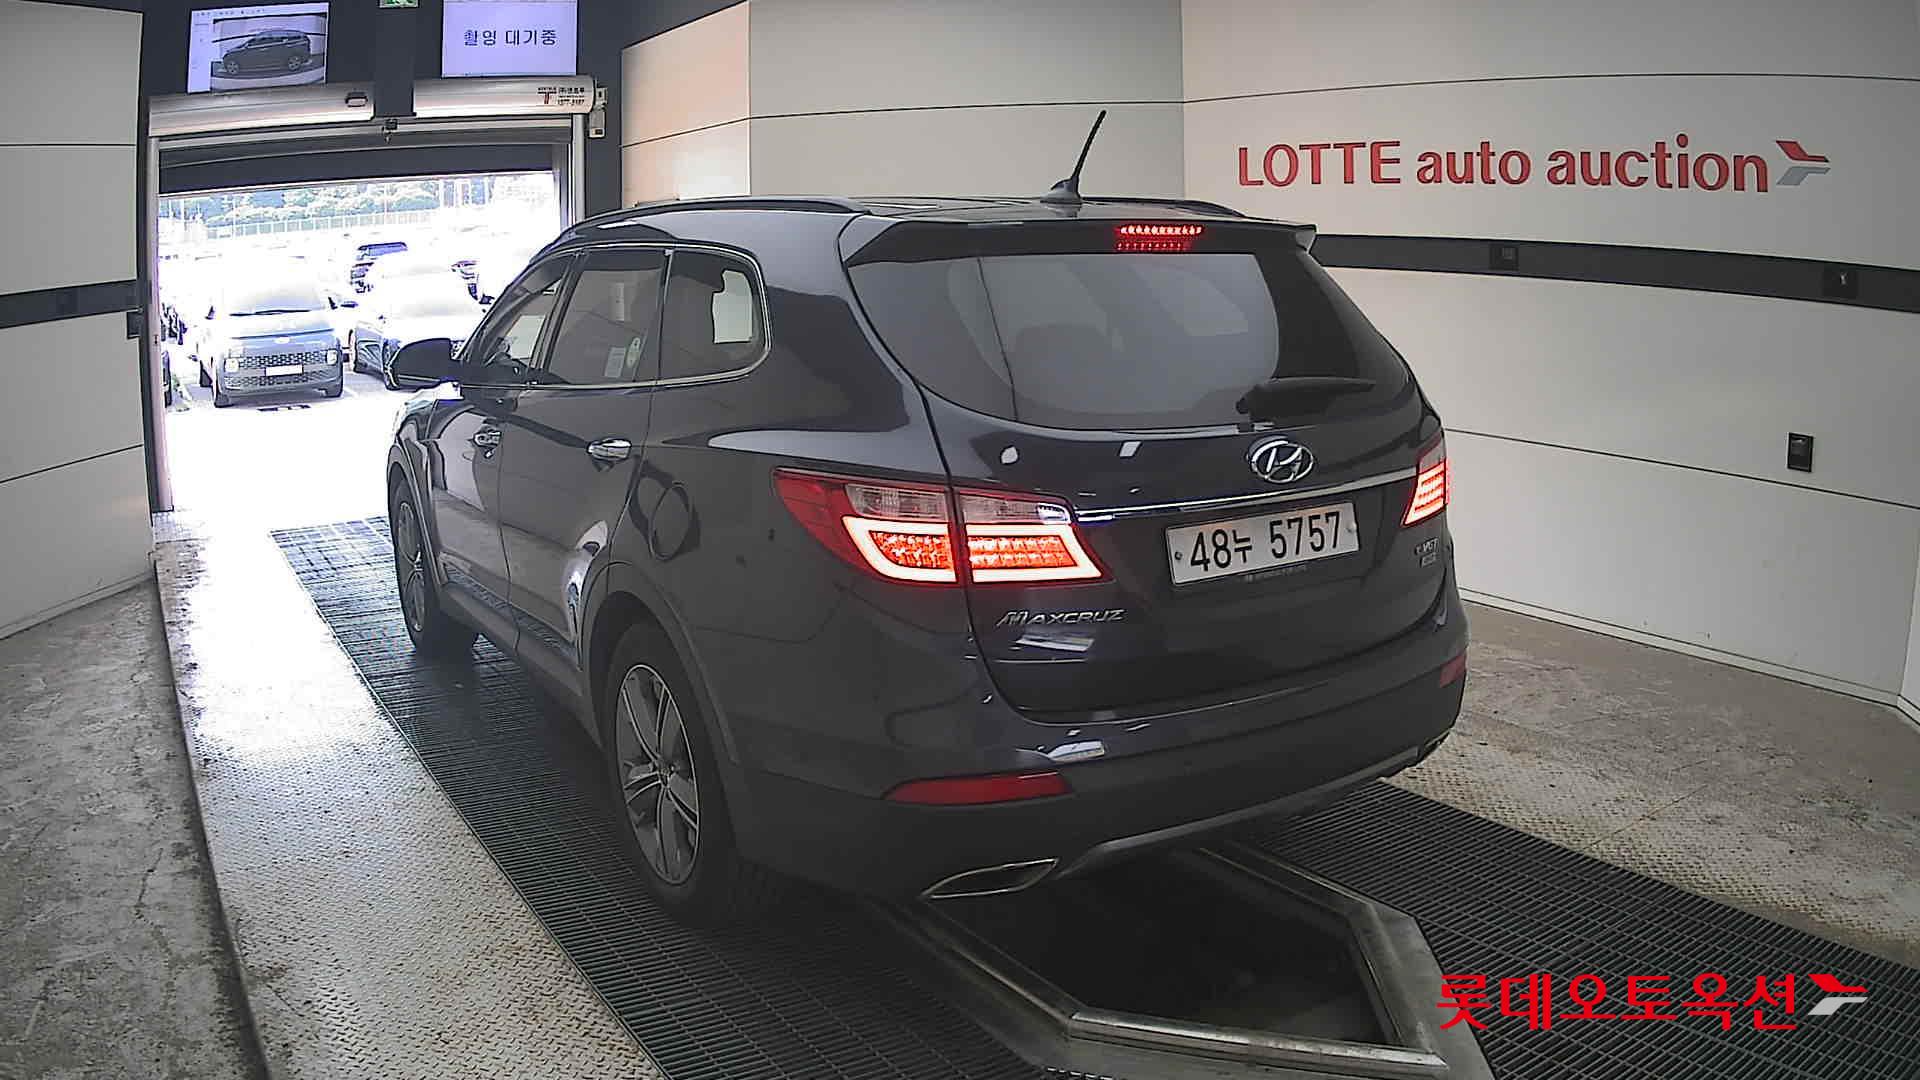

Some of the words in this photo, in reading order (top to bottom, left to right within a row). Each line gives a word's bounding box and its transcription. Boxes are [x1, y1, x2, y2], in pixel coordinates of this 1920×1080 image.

[505, 29, 557, 46] 대기중
[1238, 141, 1401, 187] LOTTE
[1416, 141, 1532, 185] auto
[1546, 133, 1769, 192] auction
[1190, 528, 1254, 573] 48누
[1269, 511, 1341, 560] 5757
[994, 608, 1127, 628] MAXCRUZ
